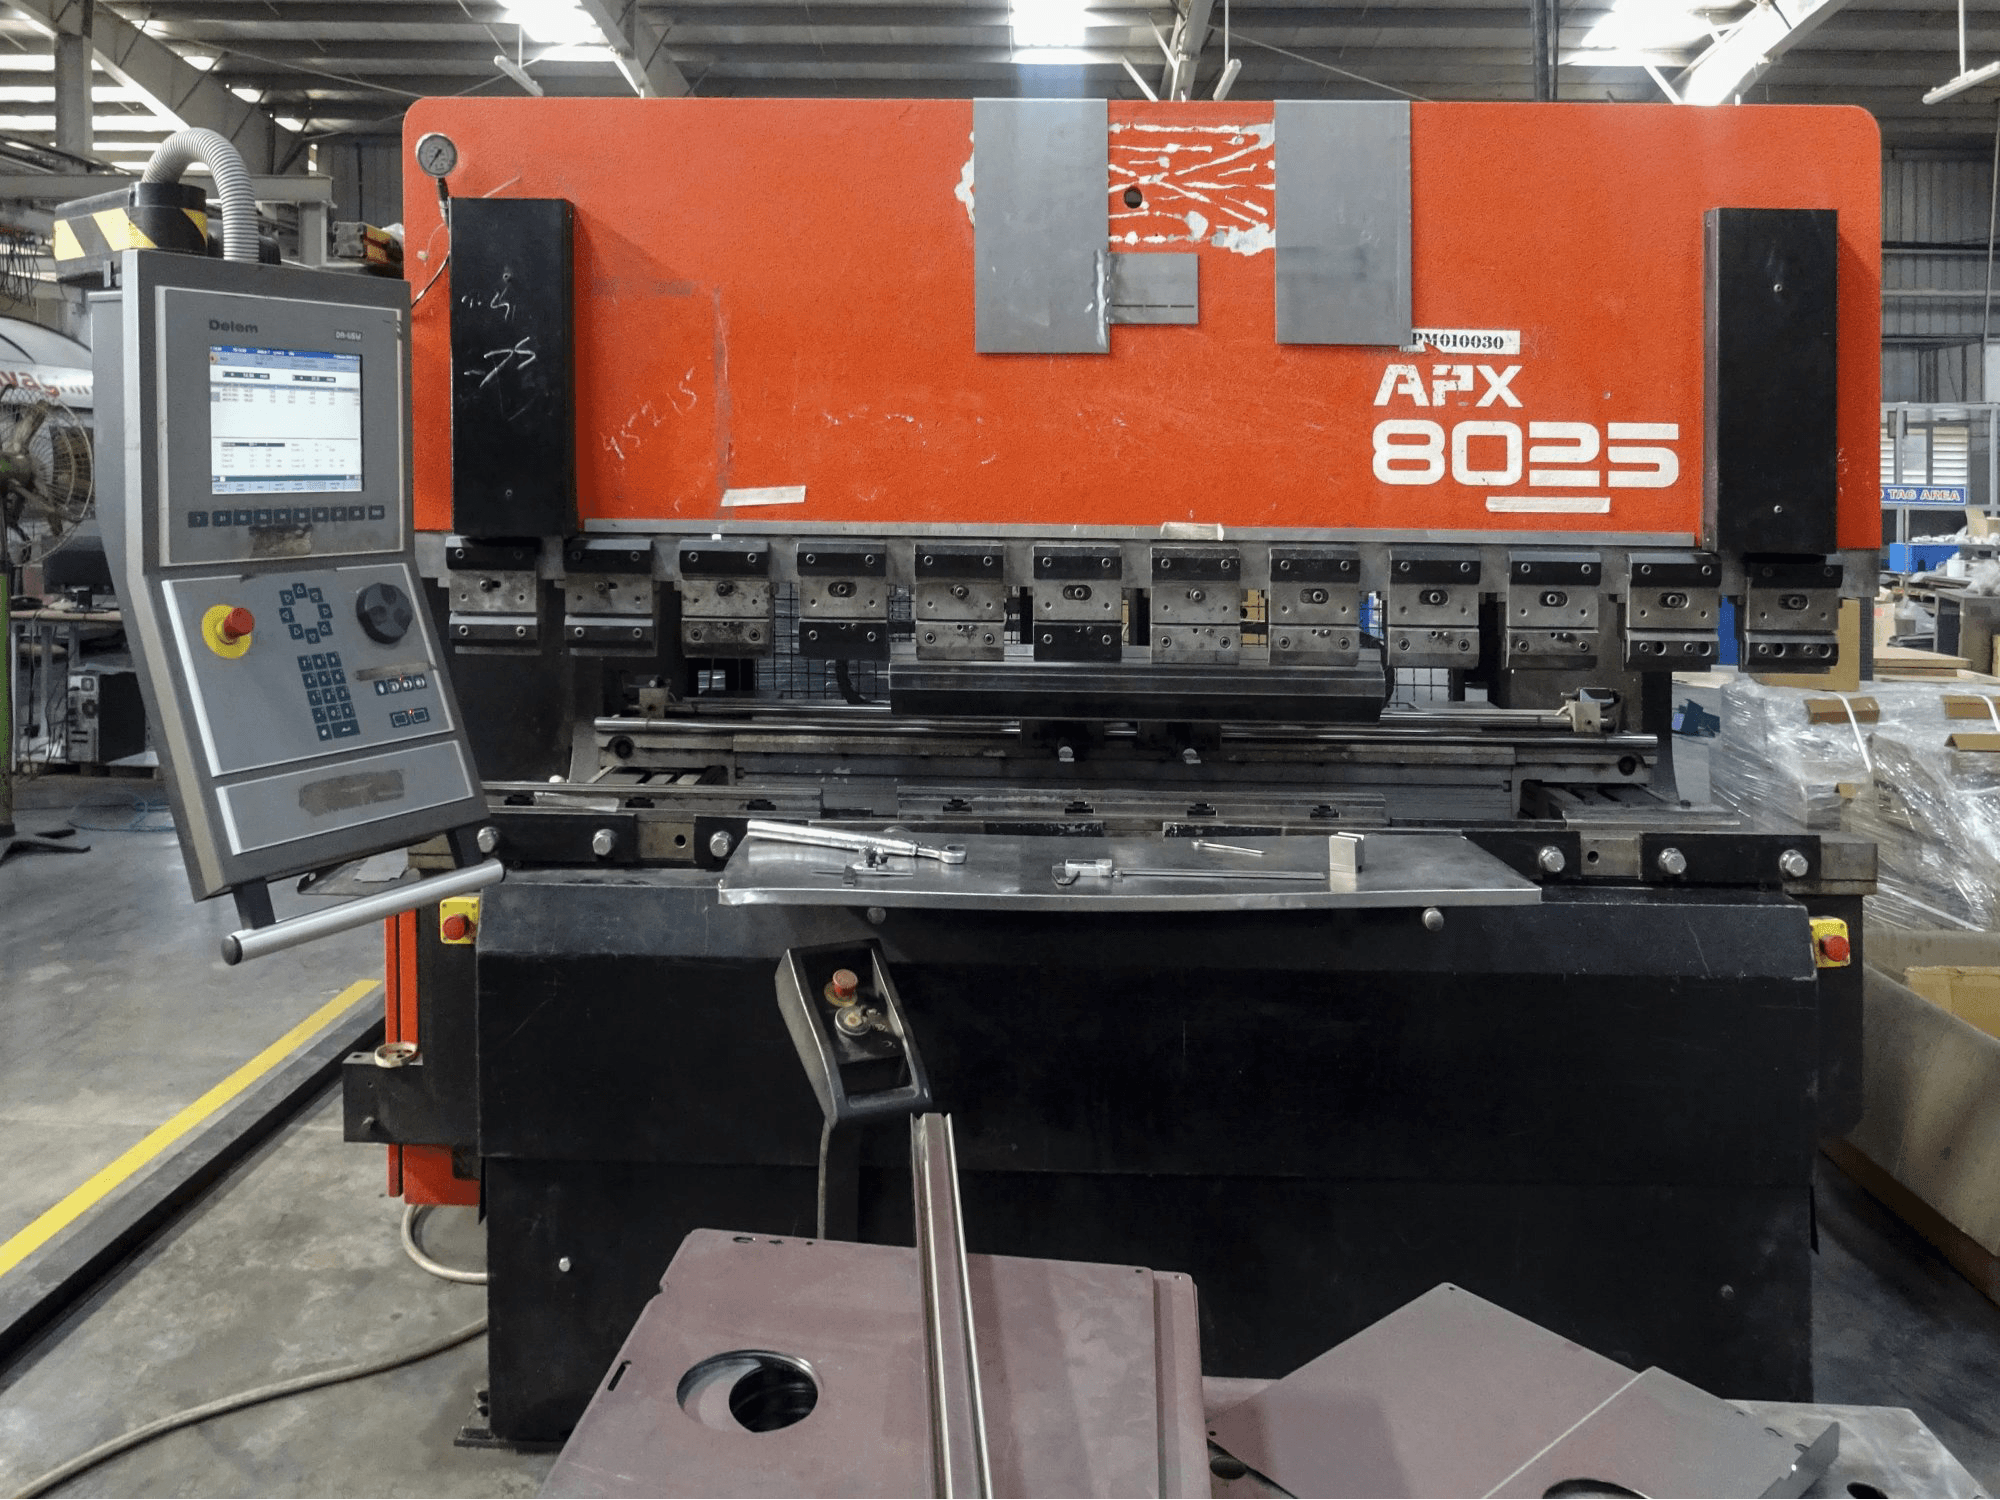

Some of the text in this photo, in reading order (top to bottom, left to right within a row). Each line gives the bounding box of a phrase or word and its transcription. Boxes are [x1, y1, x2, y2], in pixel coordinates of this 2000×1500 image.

[209, 319, 259, 334] Delem
[1373, 364, 1523, 408] APX
[1372, 419, 1680, 488] 8025
[1888, 488, 1916, 500] TAG
[1920, 489, 1961, 501] AREA
